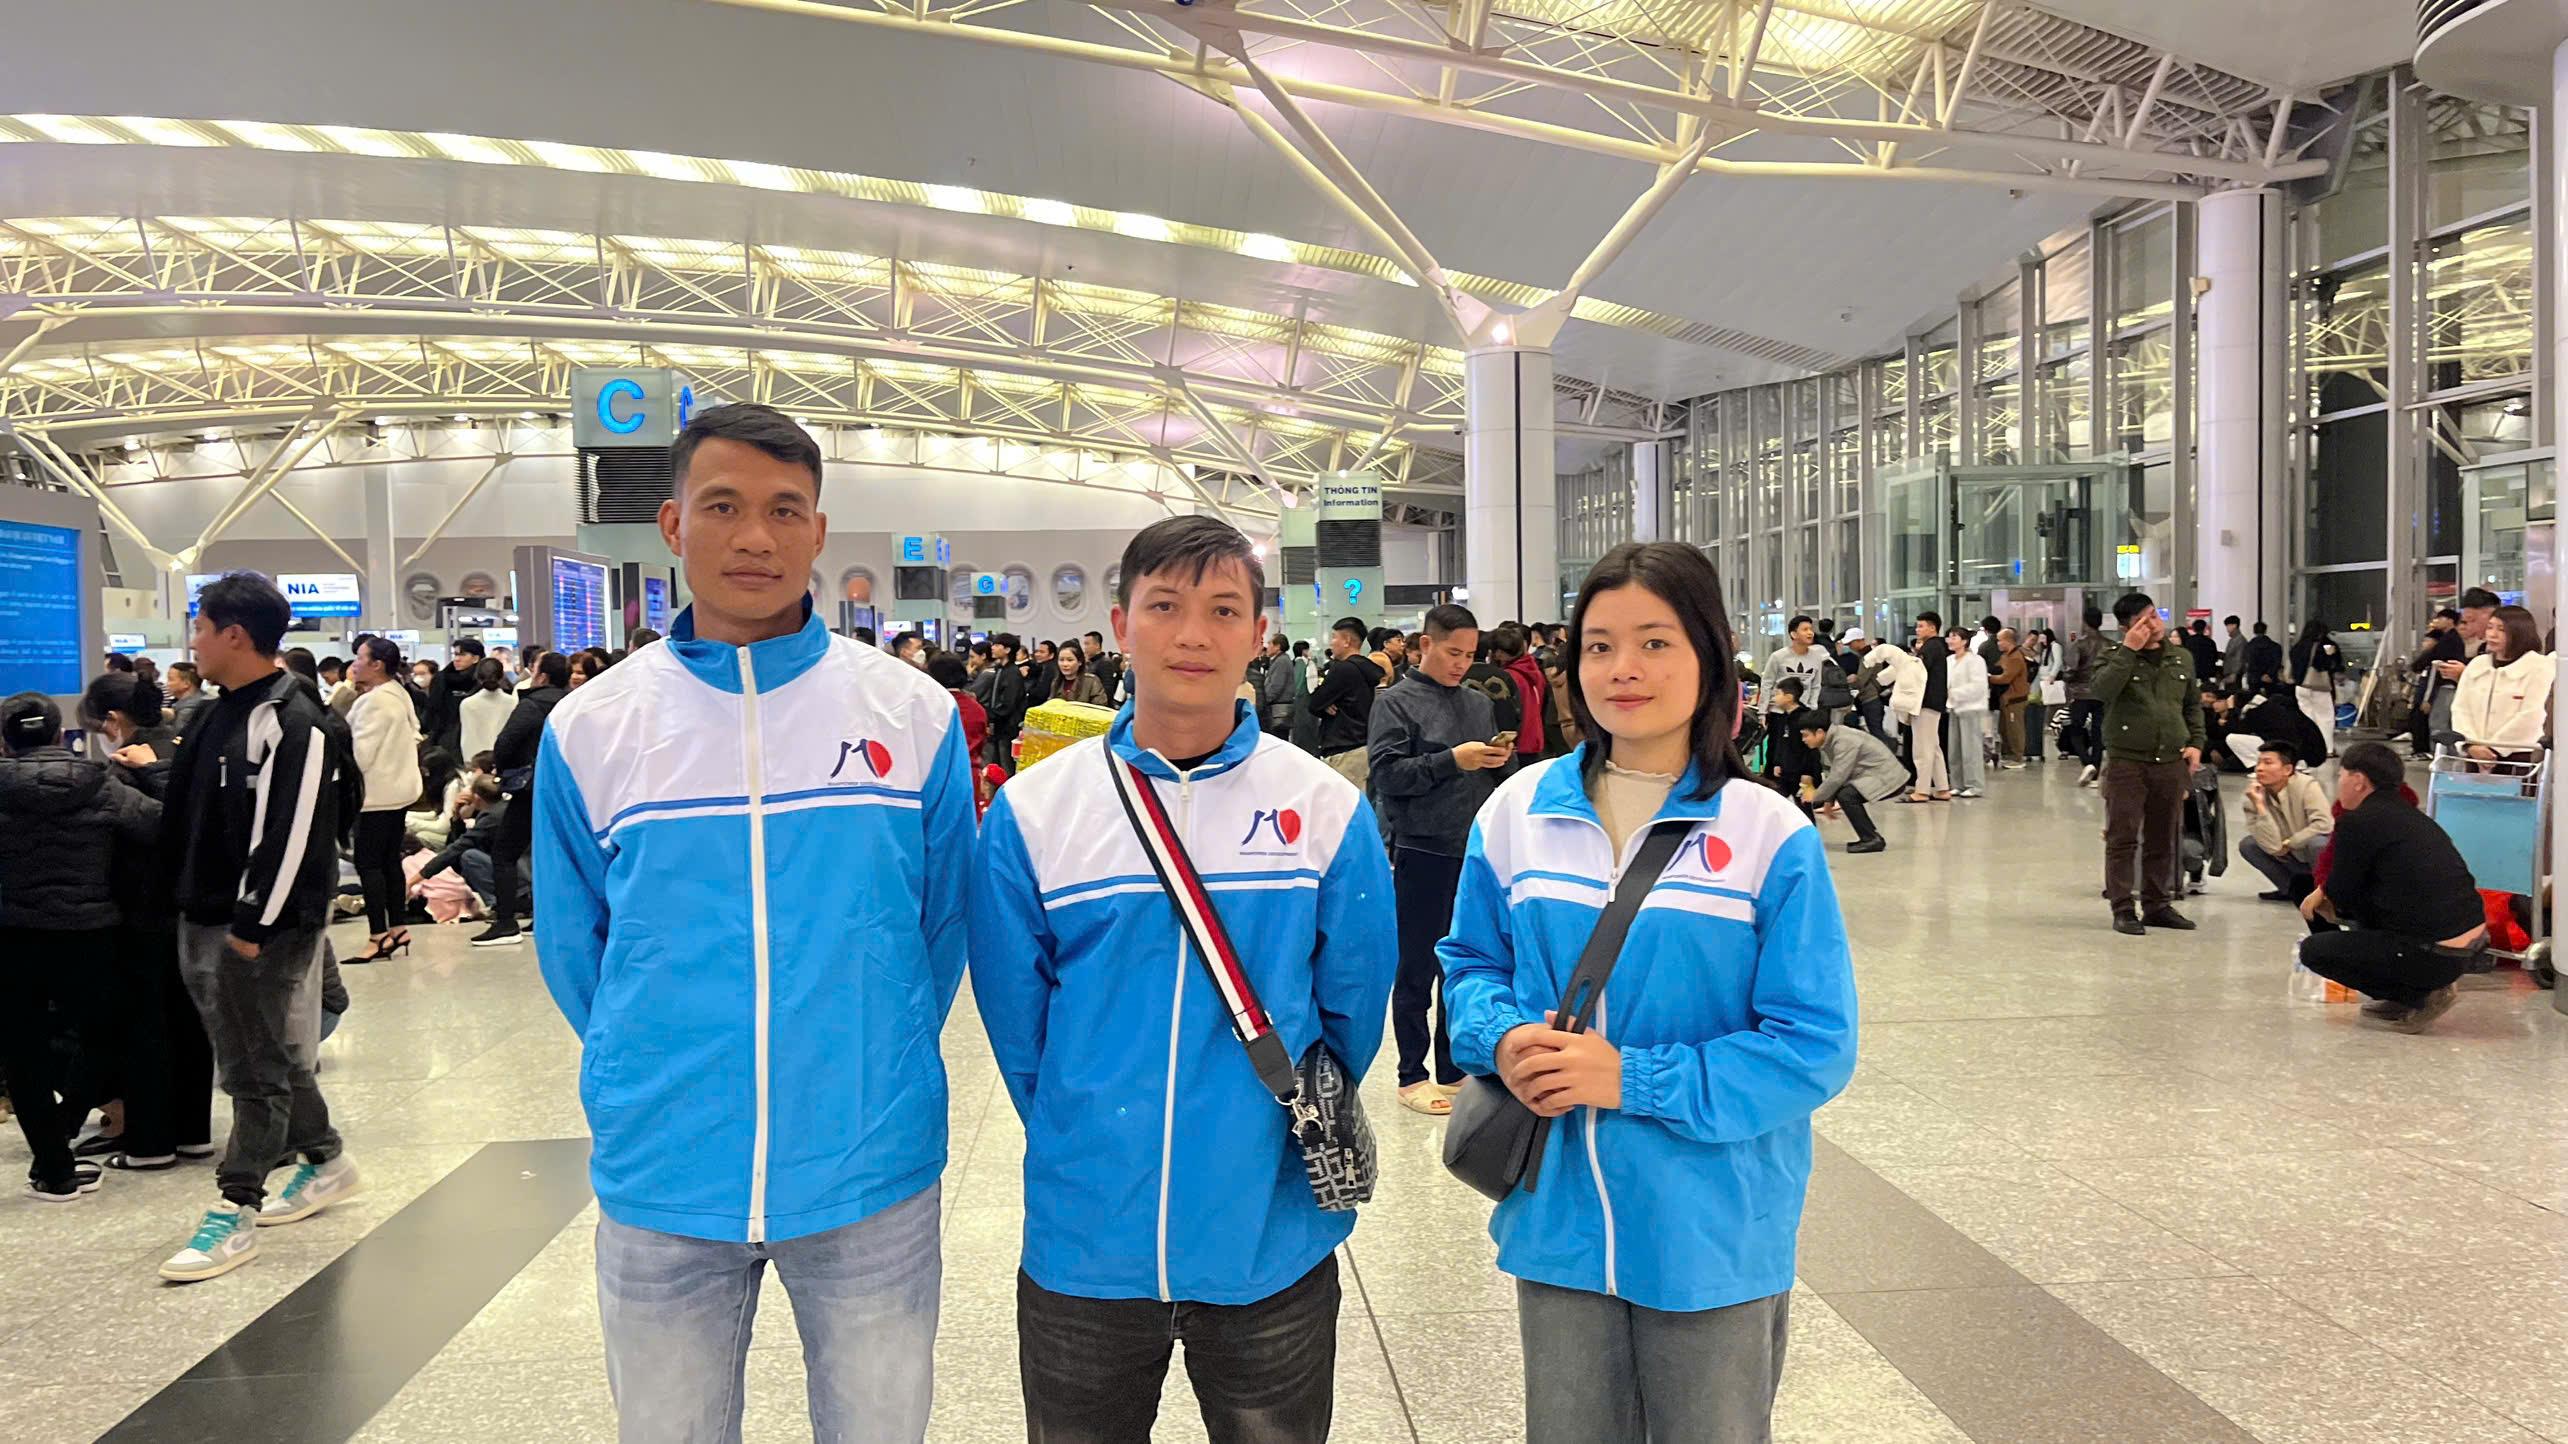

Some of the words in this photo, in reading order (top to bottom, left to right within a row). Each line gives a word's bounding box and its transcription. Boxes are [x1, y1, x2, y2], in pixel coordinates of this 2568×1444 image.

[597, 378, 645, 434] C
[1324, 484, 1360, 495] THÔNG
[1361, 486, 1378, 494] TIN
[1323, 499, 1379, 507] Information
[903, 536, 925, 561] E
[287, 582, 320, 595] NIA
[977, 575, 995, 595] G
